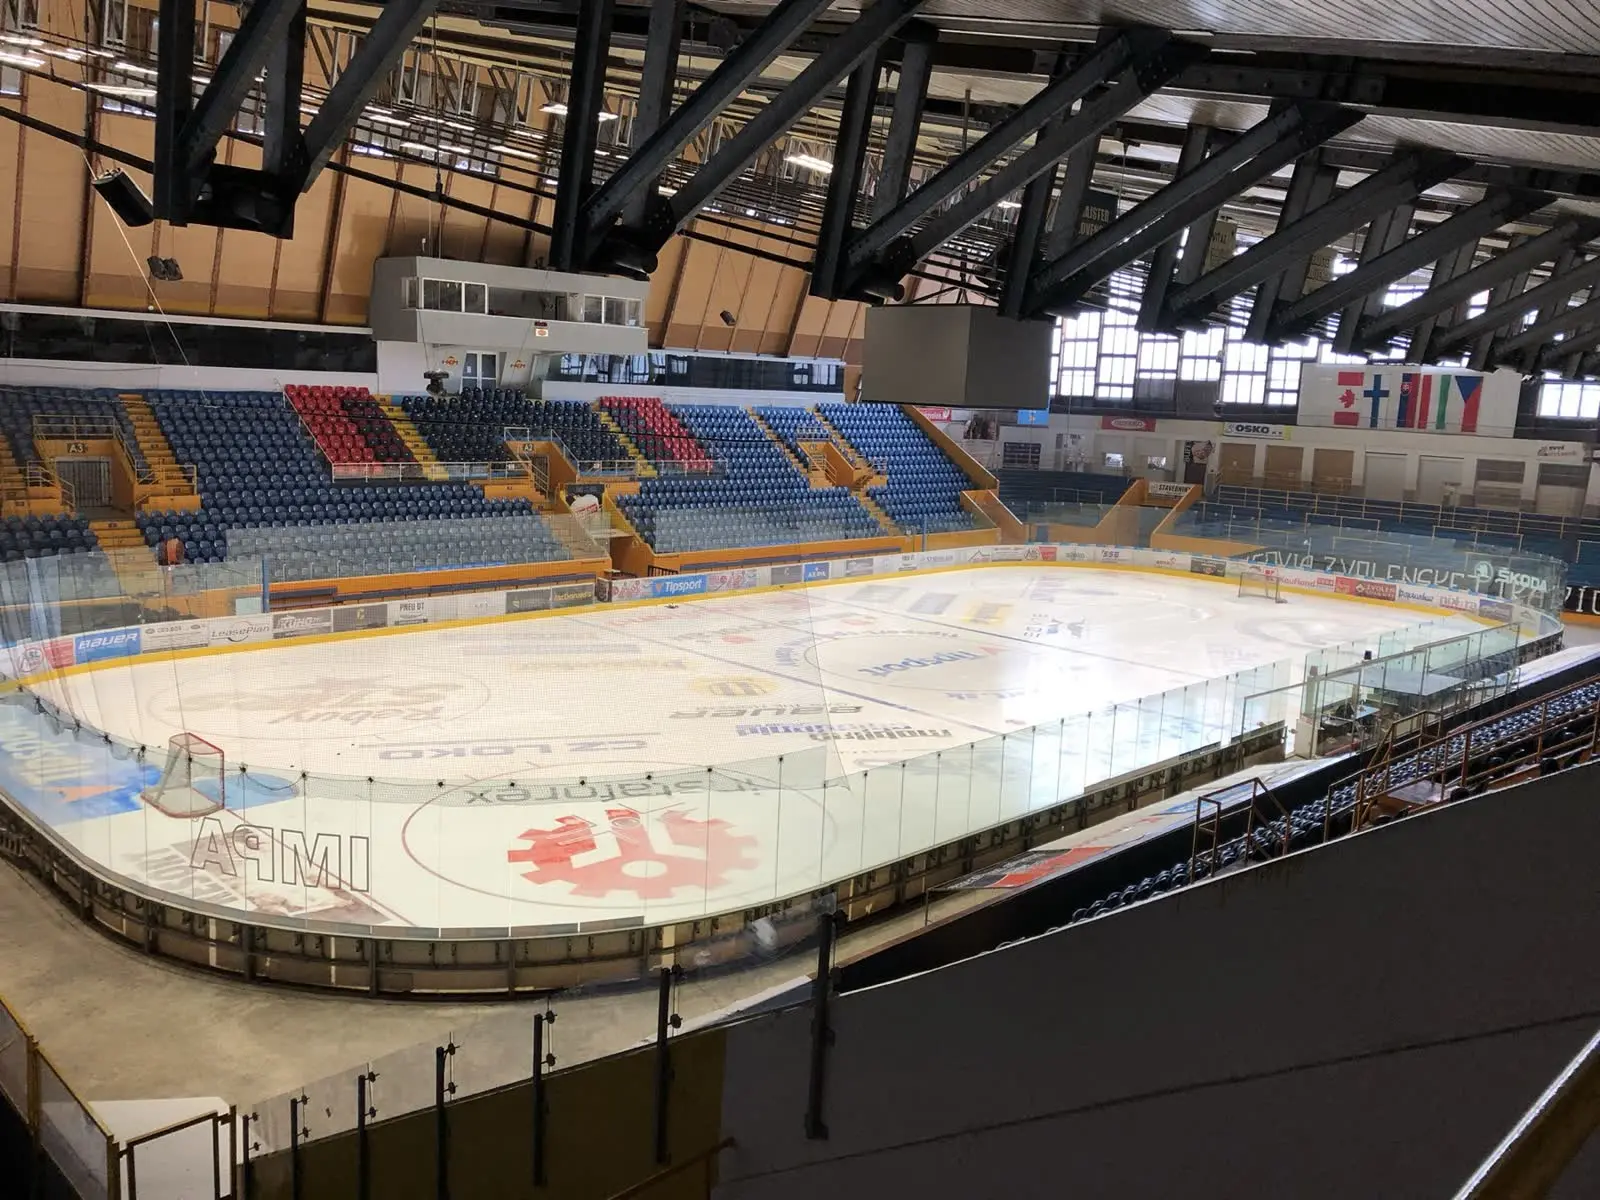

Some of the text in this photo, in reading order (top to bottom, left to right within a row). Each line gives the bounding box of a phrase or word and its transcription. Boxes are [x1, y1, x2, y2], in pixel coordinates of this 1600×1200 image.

[69, 443, 84, 453] A3
[1159, 484, 1192, 493] STAVEBNIN
[665, 579, 702, 594] Tipsport
[1497, 567, 1549, 593] ŠKODA
[212, 624, 270, 638] LeasePlan
[378, 743, 553, 759] LOKO
